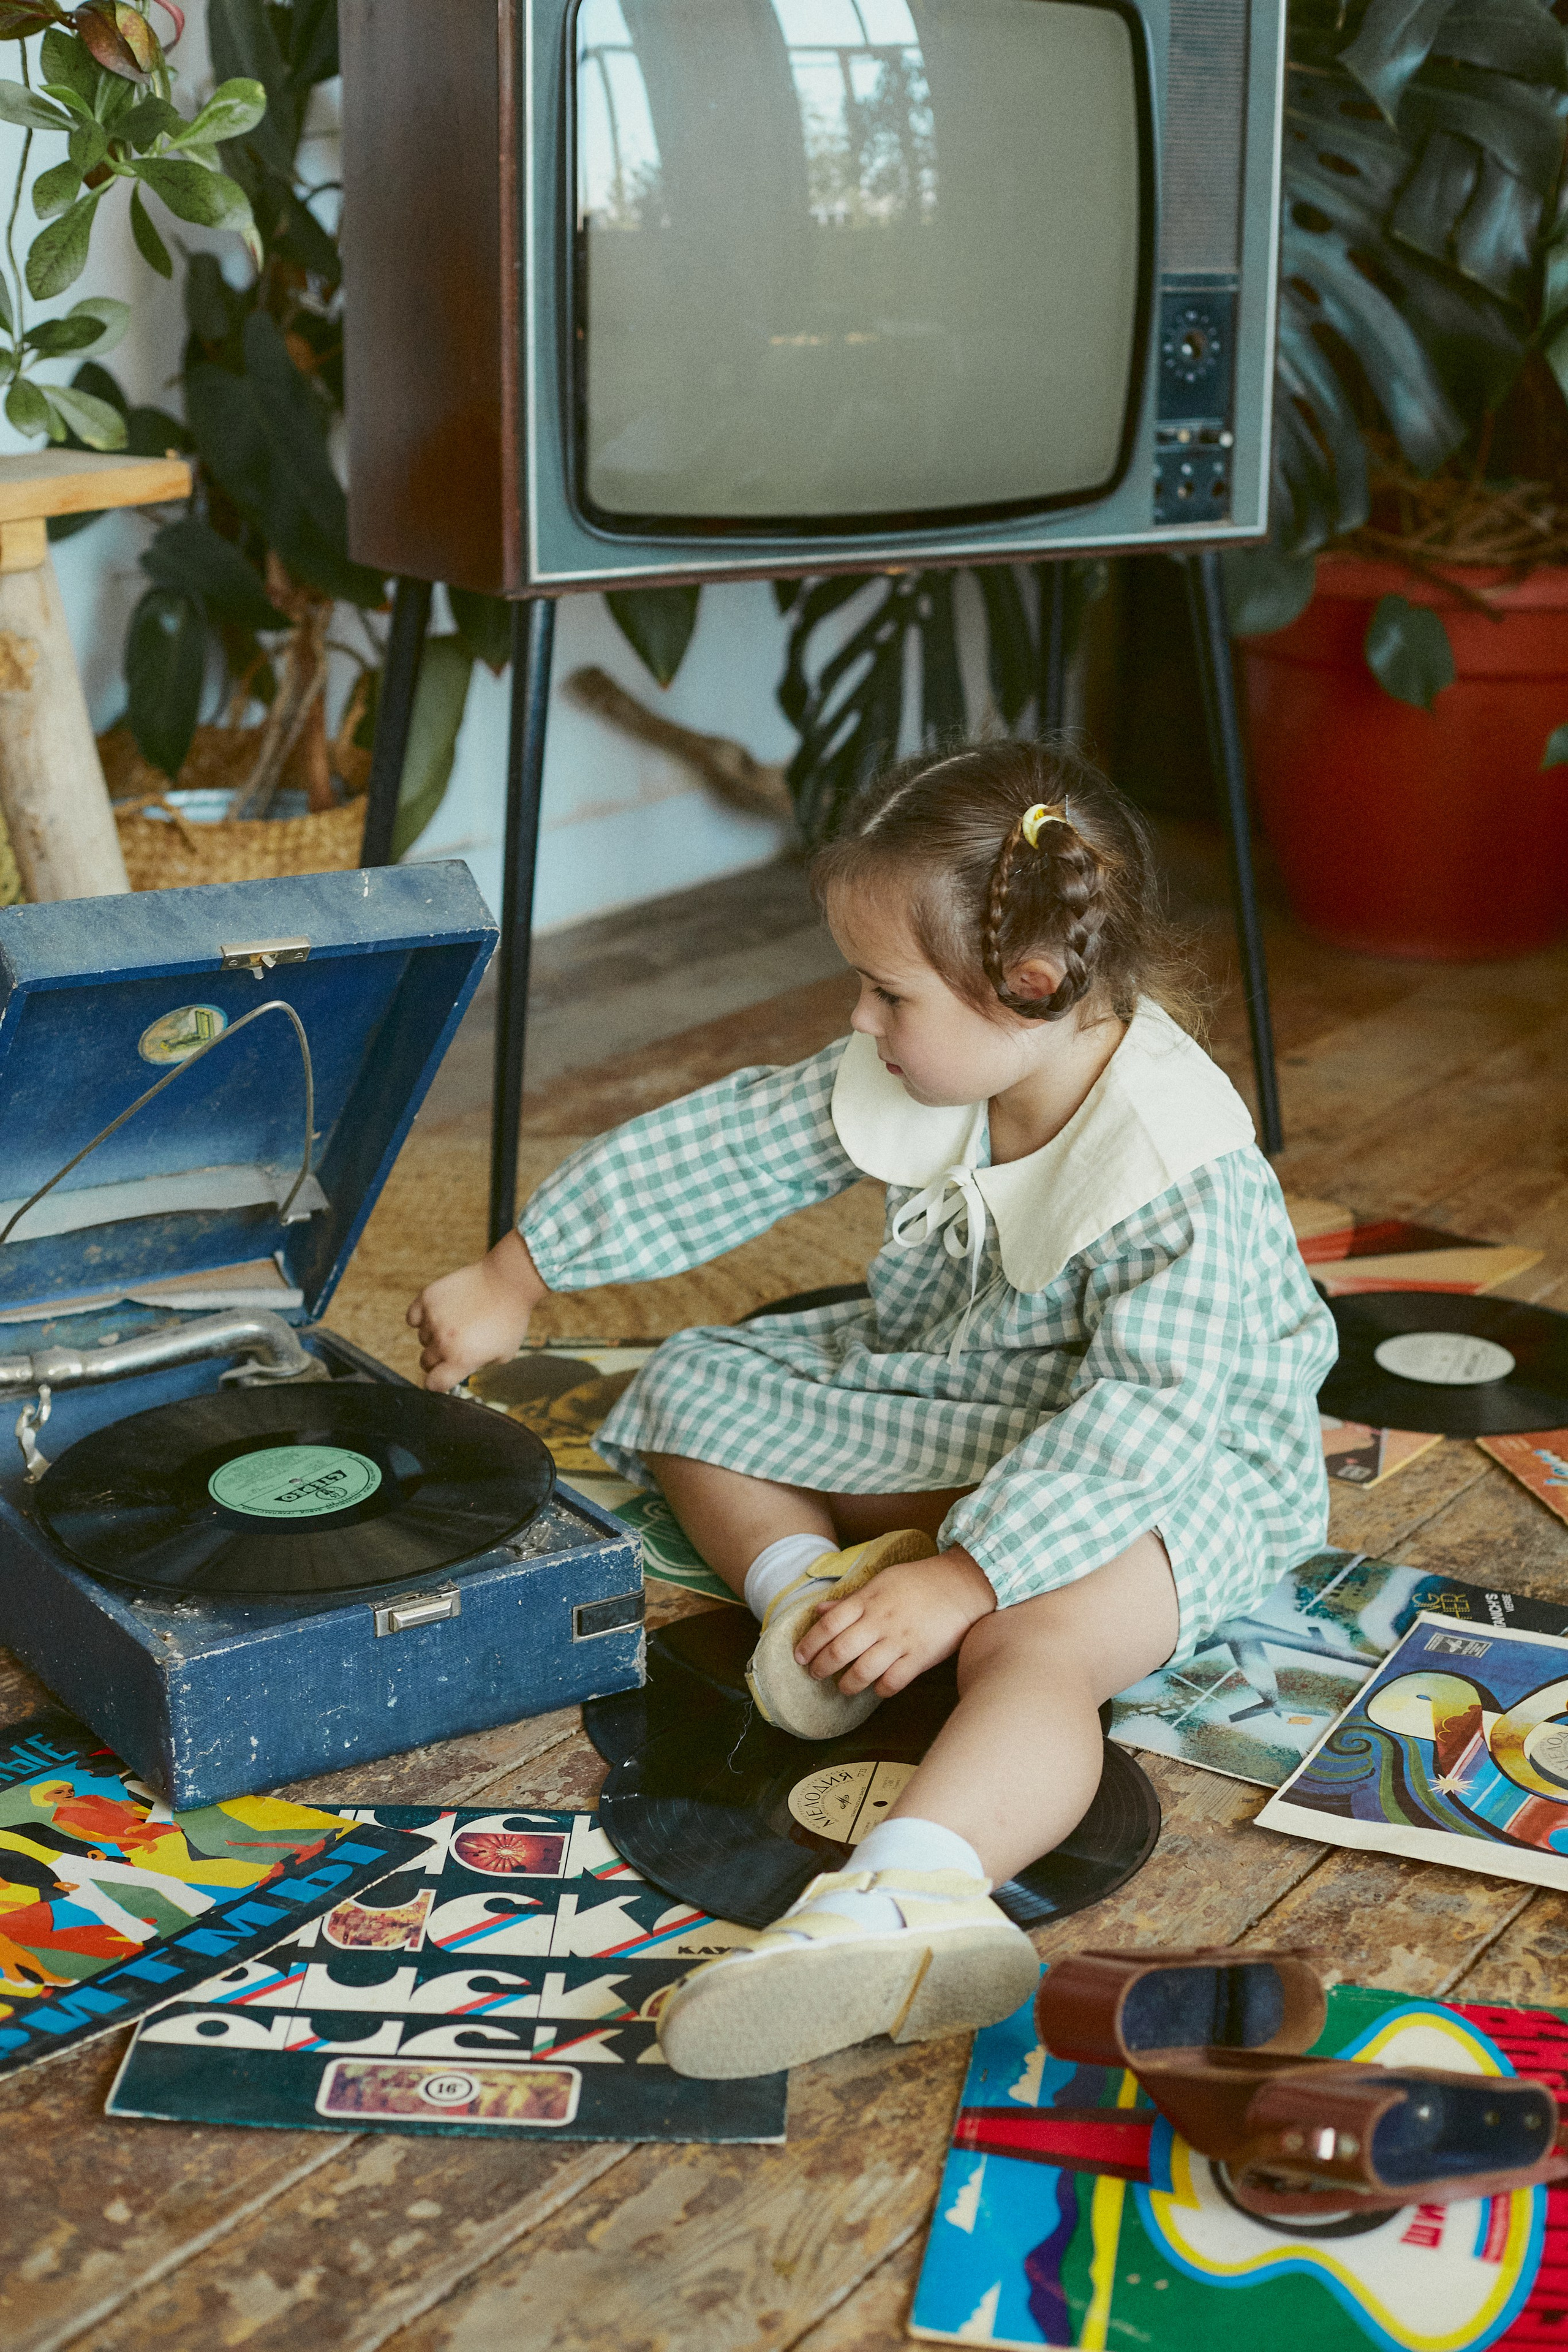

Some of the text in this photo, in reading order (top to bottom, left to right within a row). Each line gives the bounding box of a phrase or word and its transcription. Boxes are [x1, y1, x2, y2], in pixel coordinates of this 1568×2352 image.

[281, 1472, 344, 1501] СТЕРЕО
[804, 1771, 853, 1828] МЕЛОДИЯ
[438, 2082, 457, 2094] 16
